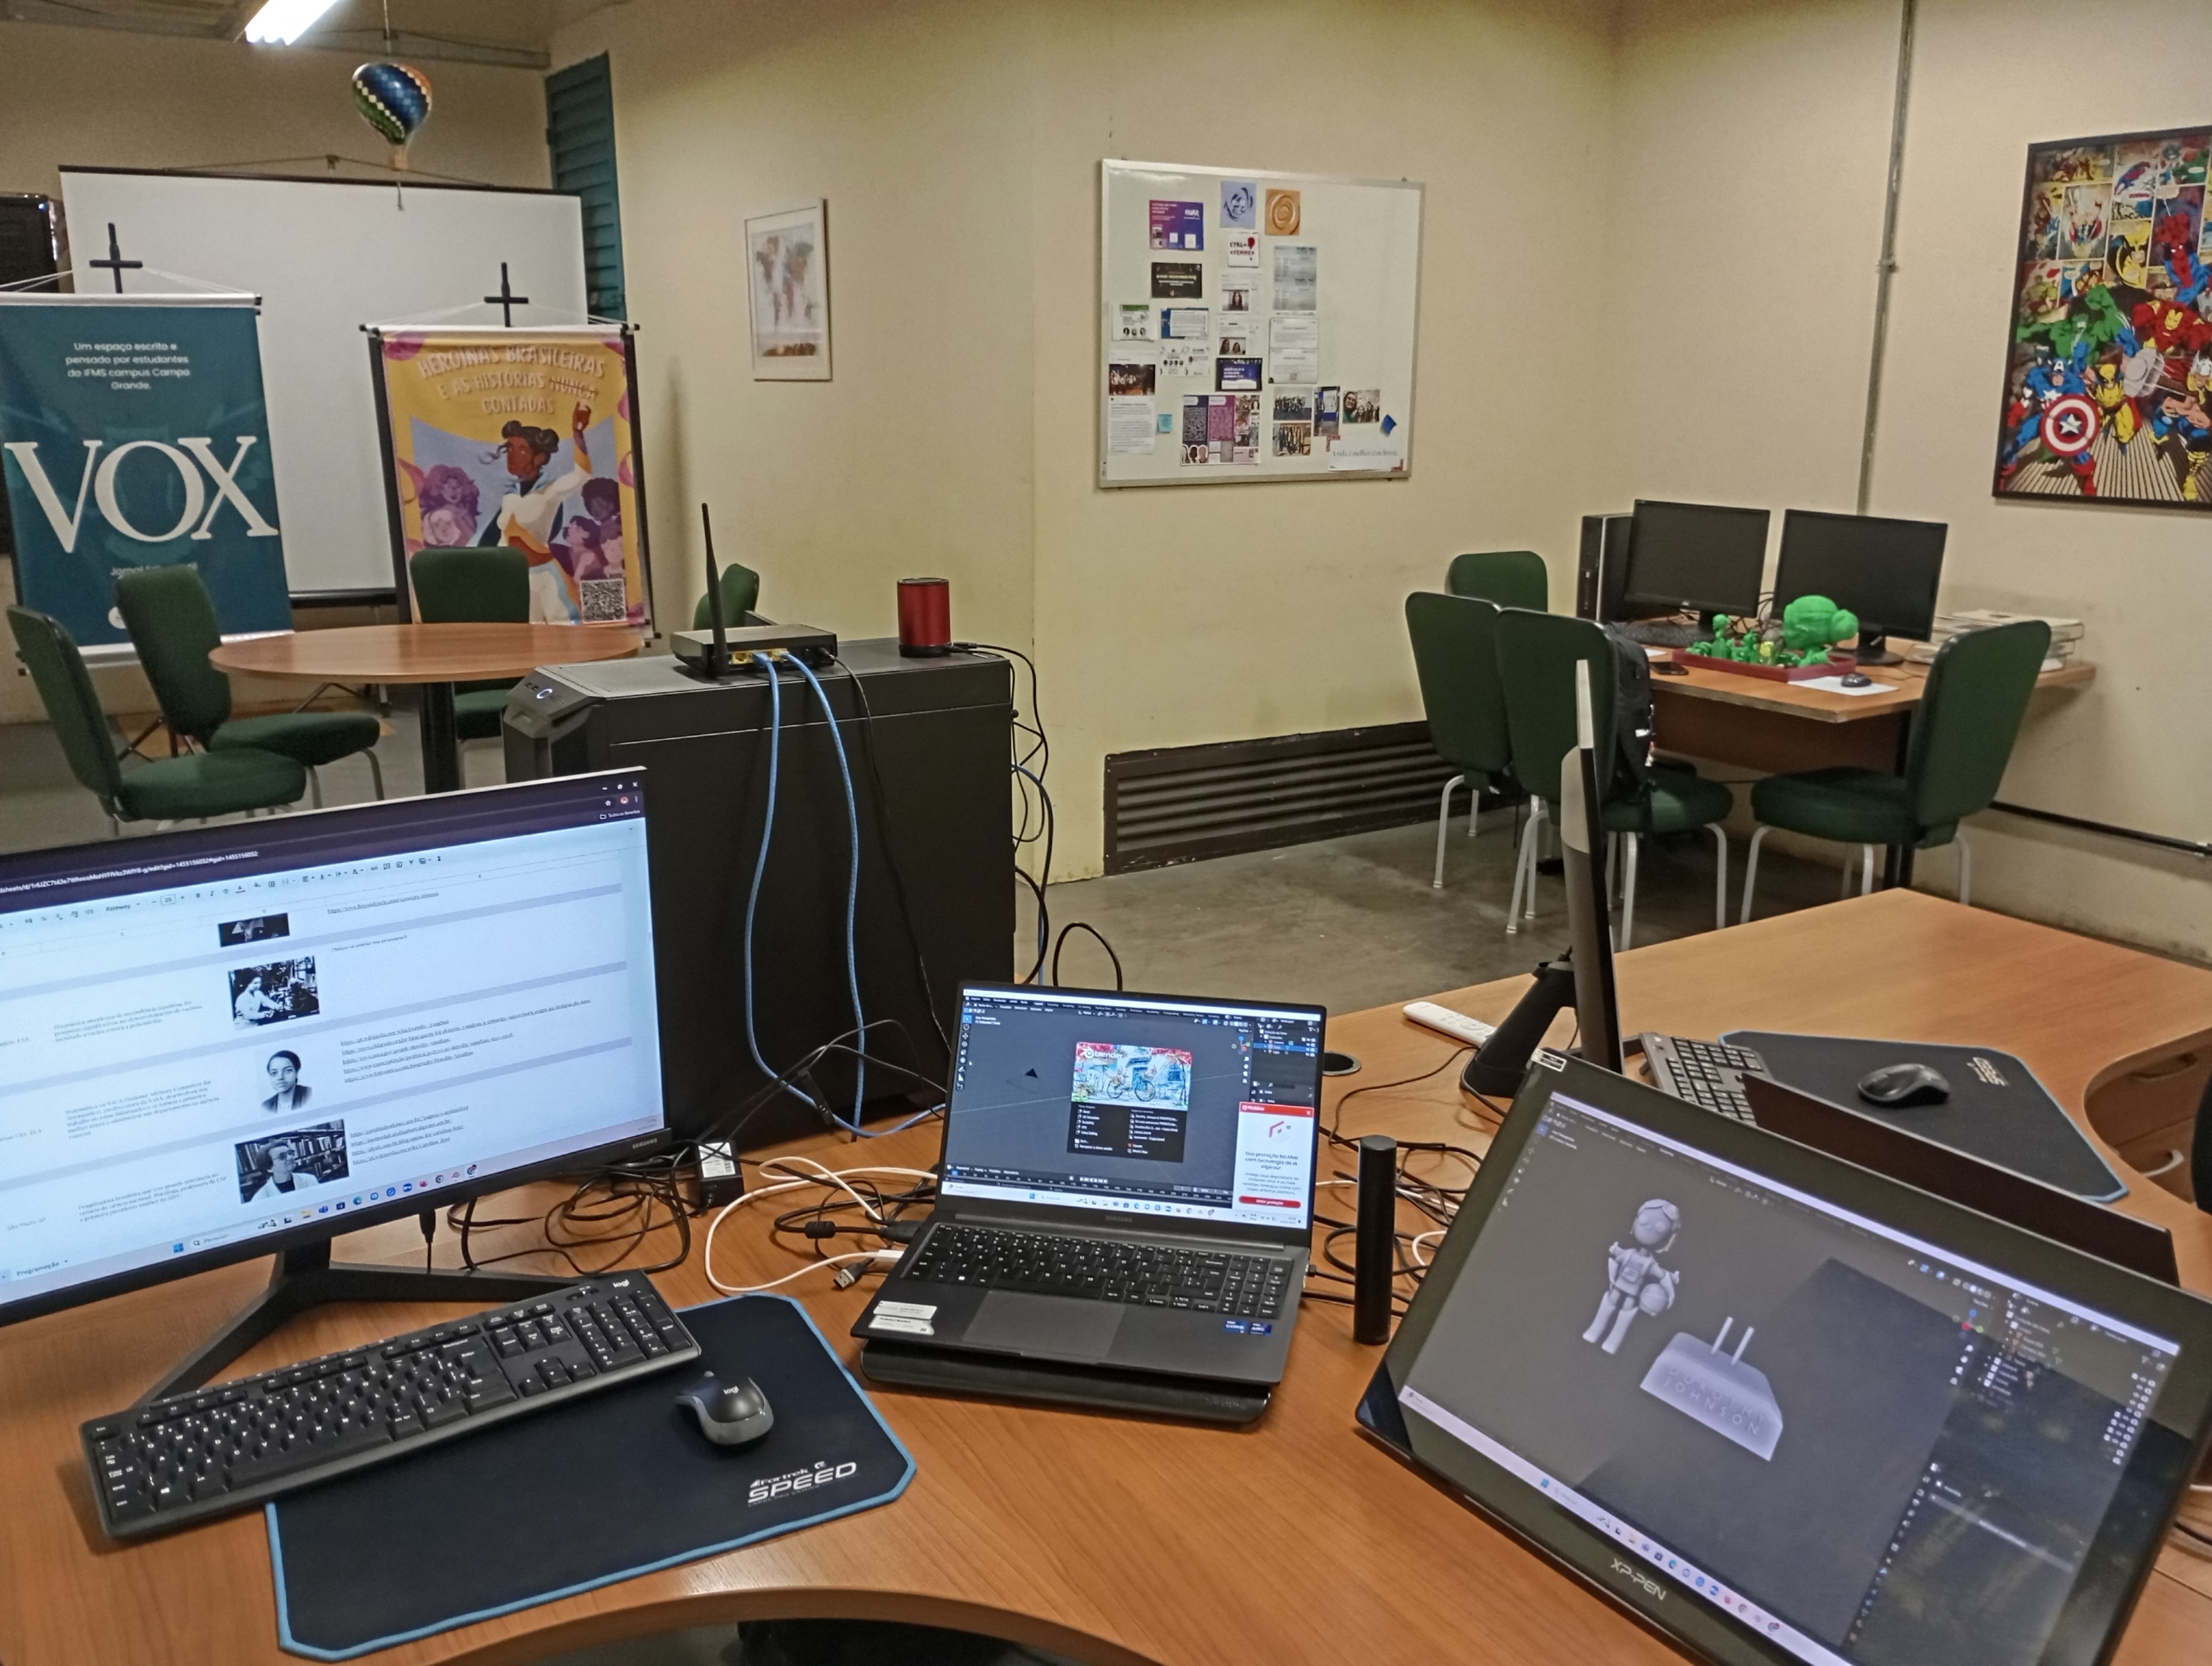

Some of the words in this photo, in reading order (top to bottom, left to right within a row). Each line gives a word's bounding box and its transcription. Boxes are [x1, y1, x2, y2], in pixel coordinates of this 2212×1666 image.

[74, 342, 92, 351] Um
[94, 343, 132, 353] espaço
[134, 342, 168, 350] escrito
[66, 355, 111, 366] pensado
[113, 356, 130, 365] por
[133, 355, 189, 363] estudantes
[506, 344, 605, 377] BRASILEIRAS
[83, 369, 107, 377] IFMS
[108, 369, 151, 379] campus
[152, 368, 190, 378] Campo
[452, 379, 470, 395] AS
[483, 396, 555, 414] CONTADAS
[4, 435, 279, 554] VOX
[106, 904, 131, 912] Raleway
[16, 1261, 60, 1276] Programação
[613, 1279, 630, 1289] logi
[723, 1386, 740, 1395] logi
[748, 1462, 857, 1503] SPEED
[1610, 1557, 1667, 1600] XP-PEN
